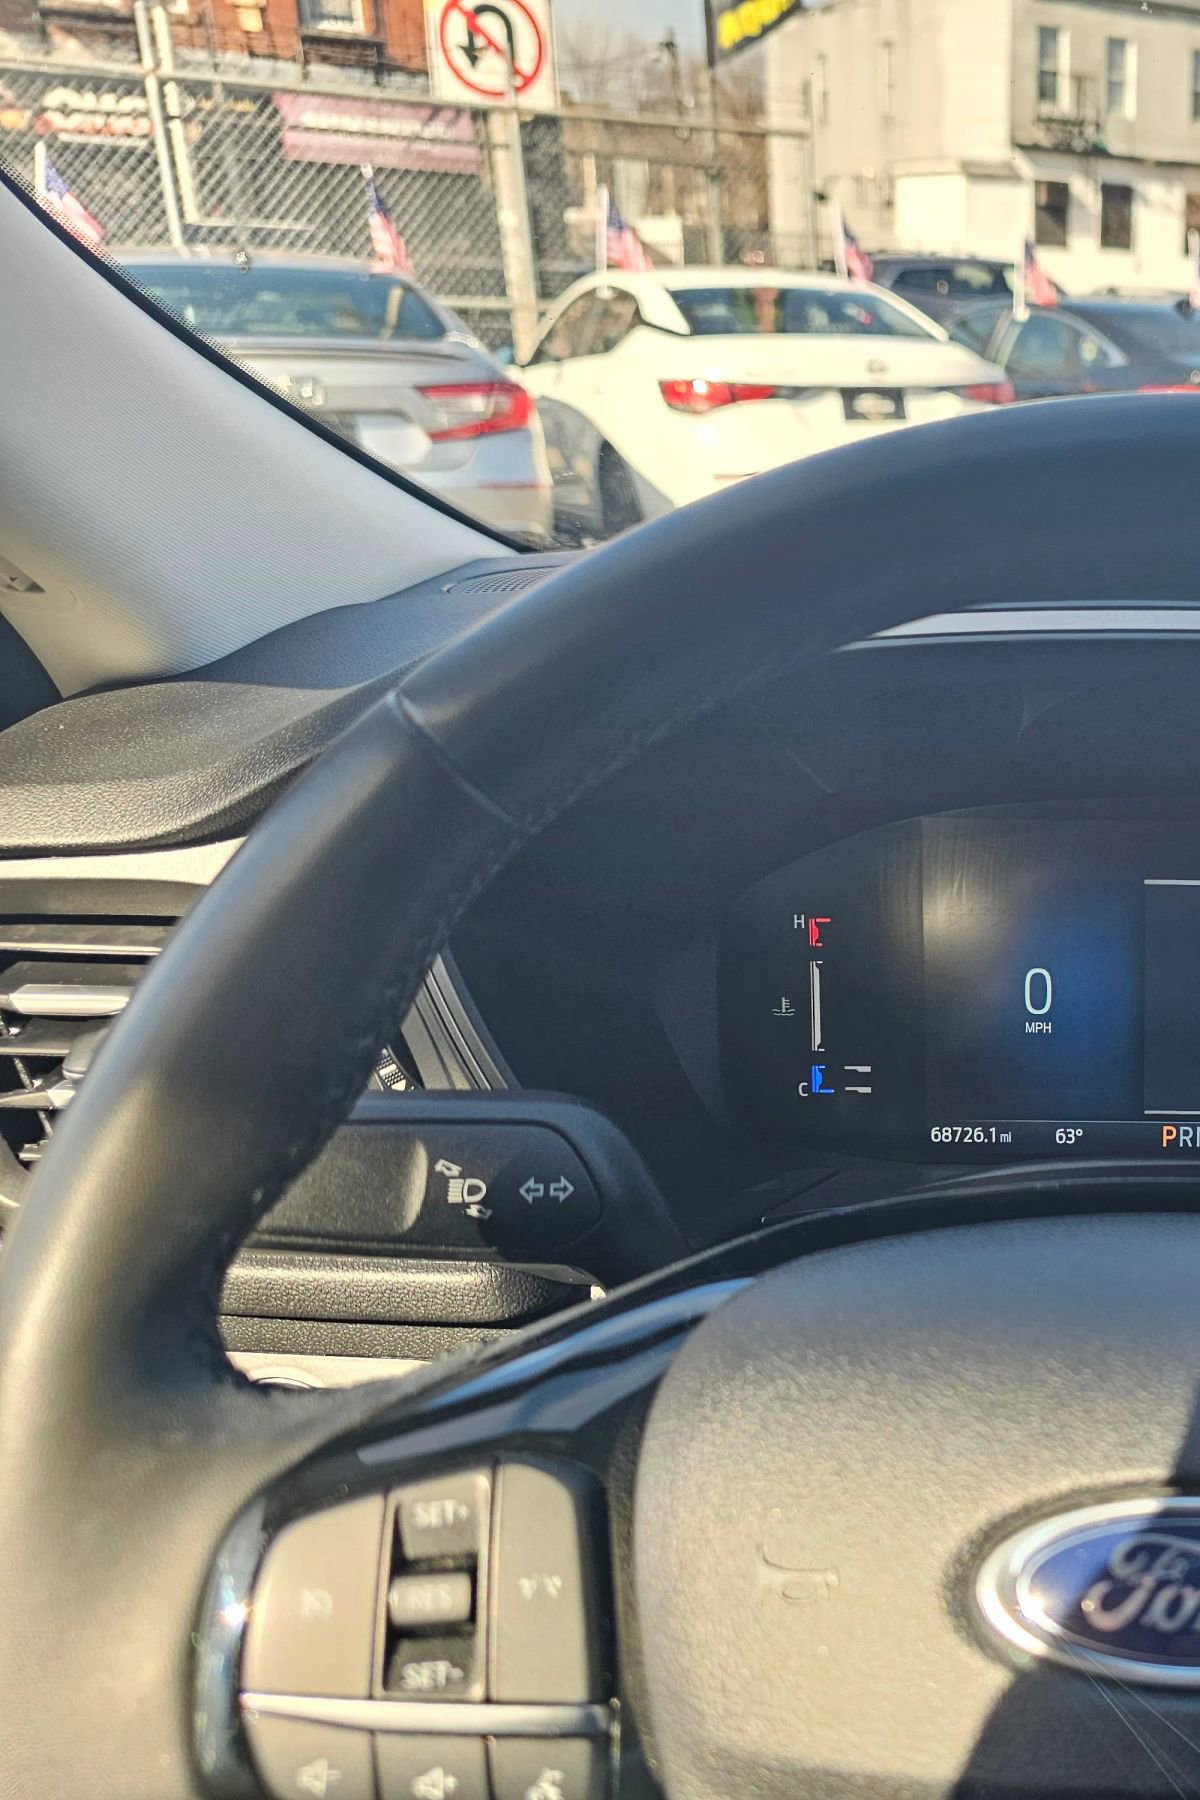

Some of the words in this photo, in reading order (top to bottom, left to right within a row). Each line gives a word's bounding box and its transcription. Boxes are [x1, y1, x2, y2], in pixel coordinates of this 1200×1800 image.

[793, 914, 806, 929] H
[1024, 967, 1053, 1015] 0
[1025, 1021, 1053, 1034] MPH
[798, 1082, 810, 1097] C
[930, 1126, 998, 1144] 68726.1
[1055, 1128, 1084, 1144] 63°
